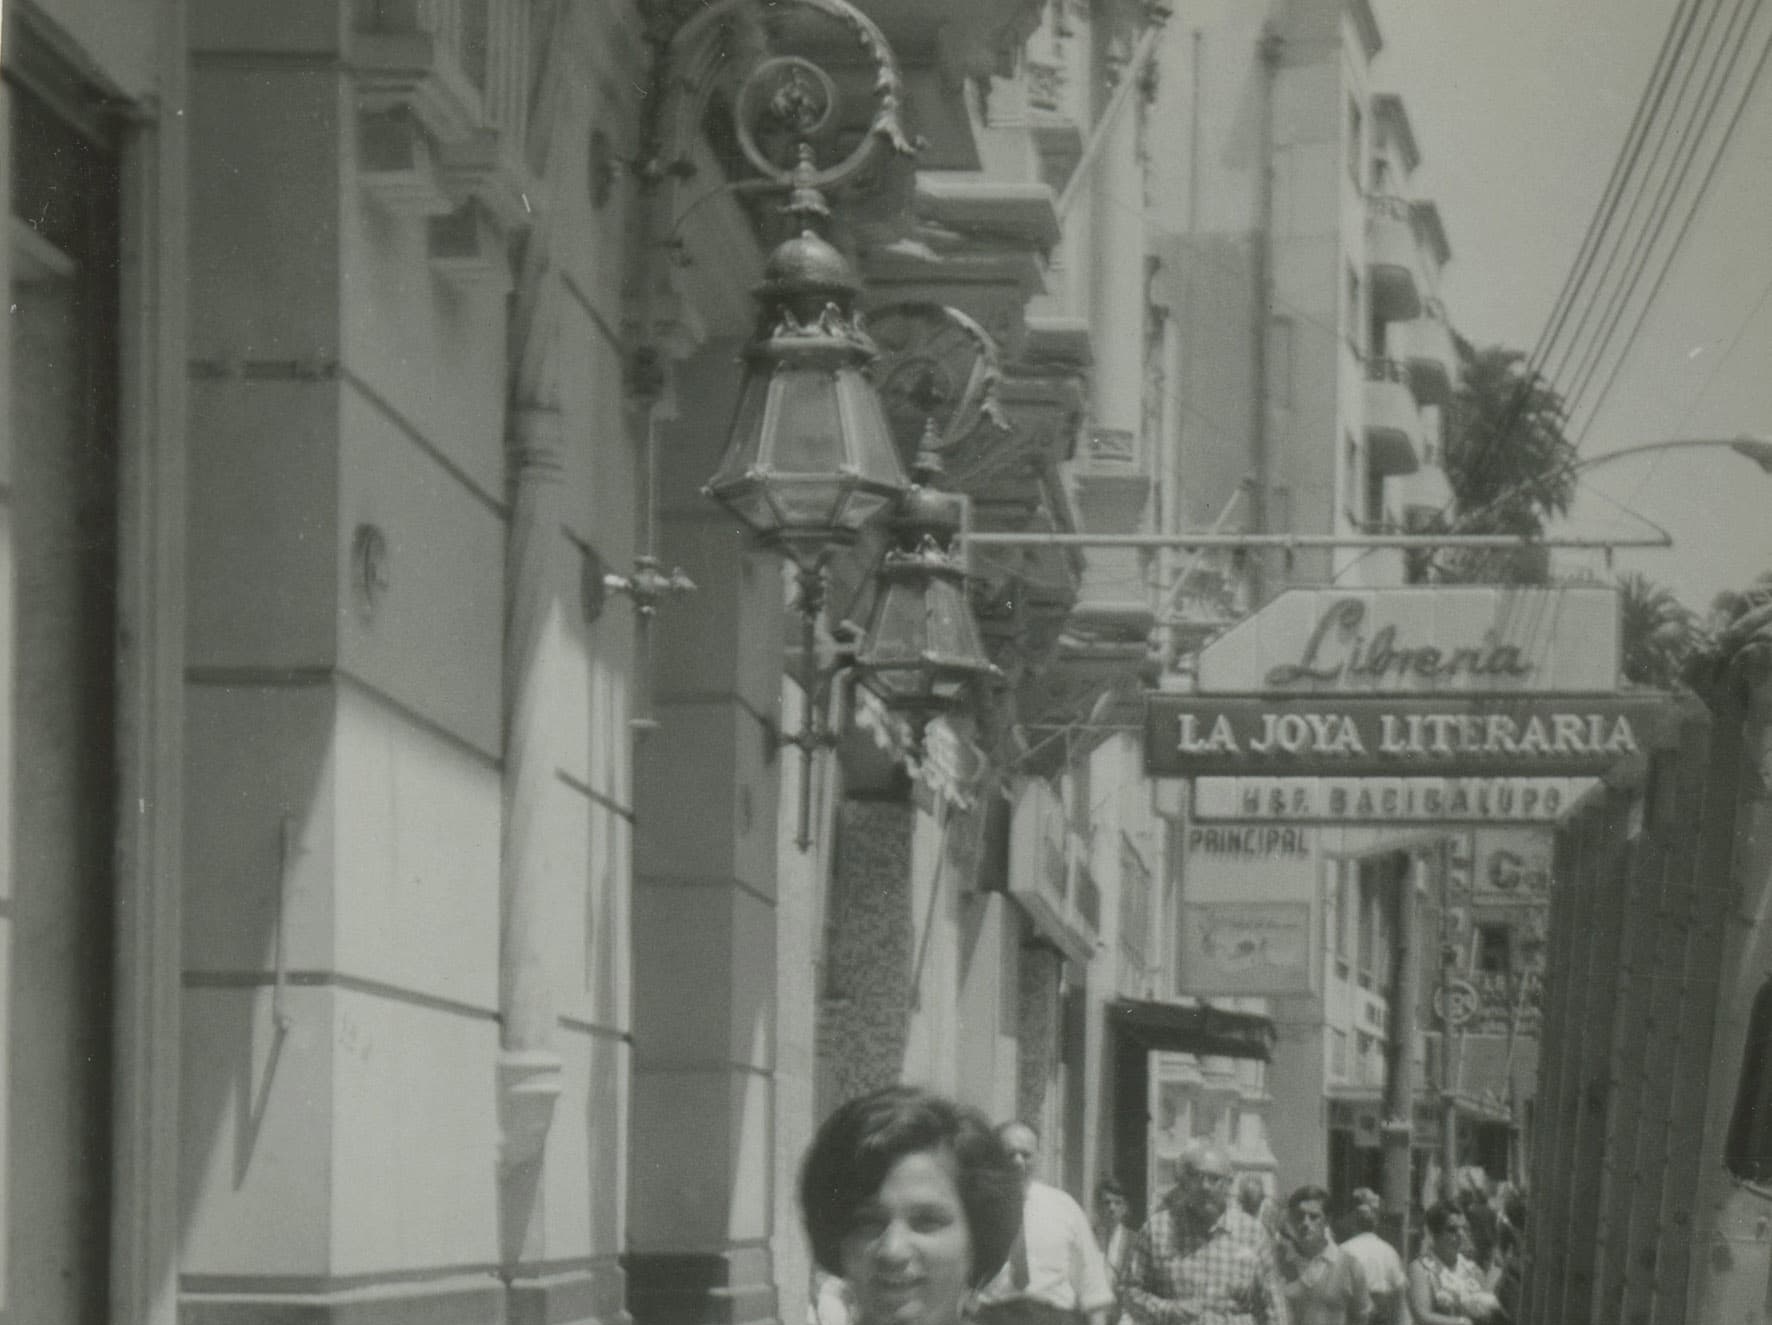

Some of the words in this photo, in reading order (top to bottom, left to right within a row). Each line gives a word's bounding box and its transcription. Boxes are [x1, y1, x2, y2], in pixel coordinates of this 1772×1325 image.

[1177, 713, 1238, 753] LA
[1250, 713, 1366, 754] JOYA
[1379, 713, 1639, 755] LITERARIA
[1190, 828, 1309, 855] PRINCIPAL
